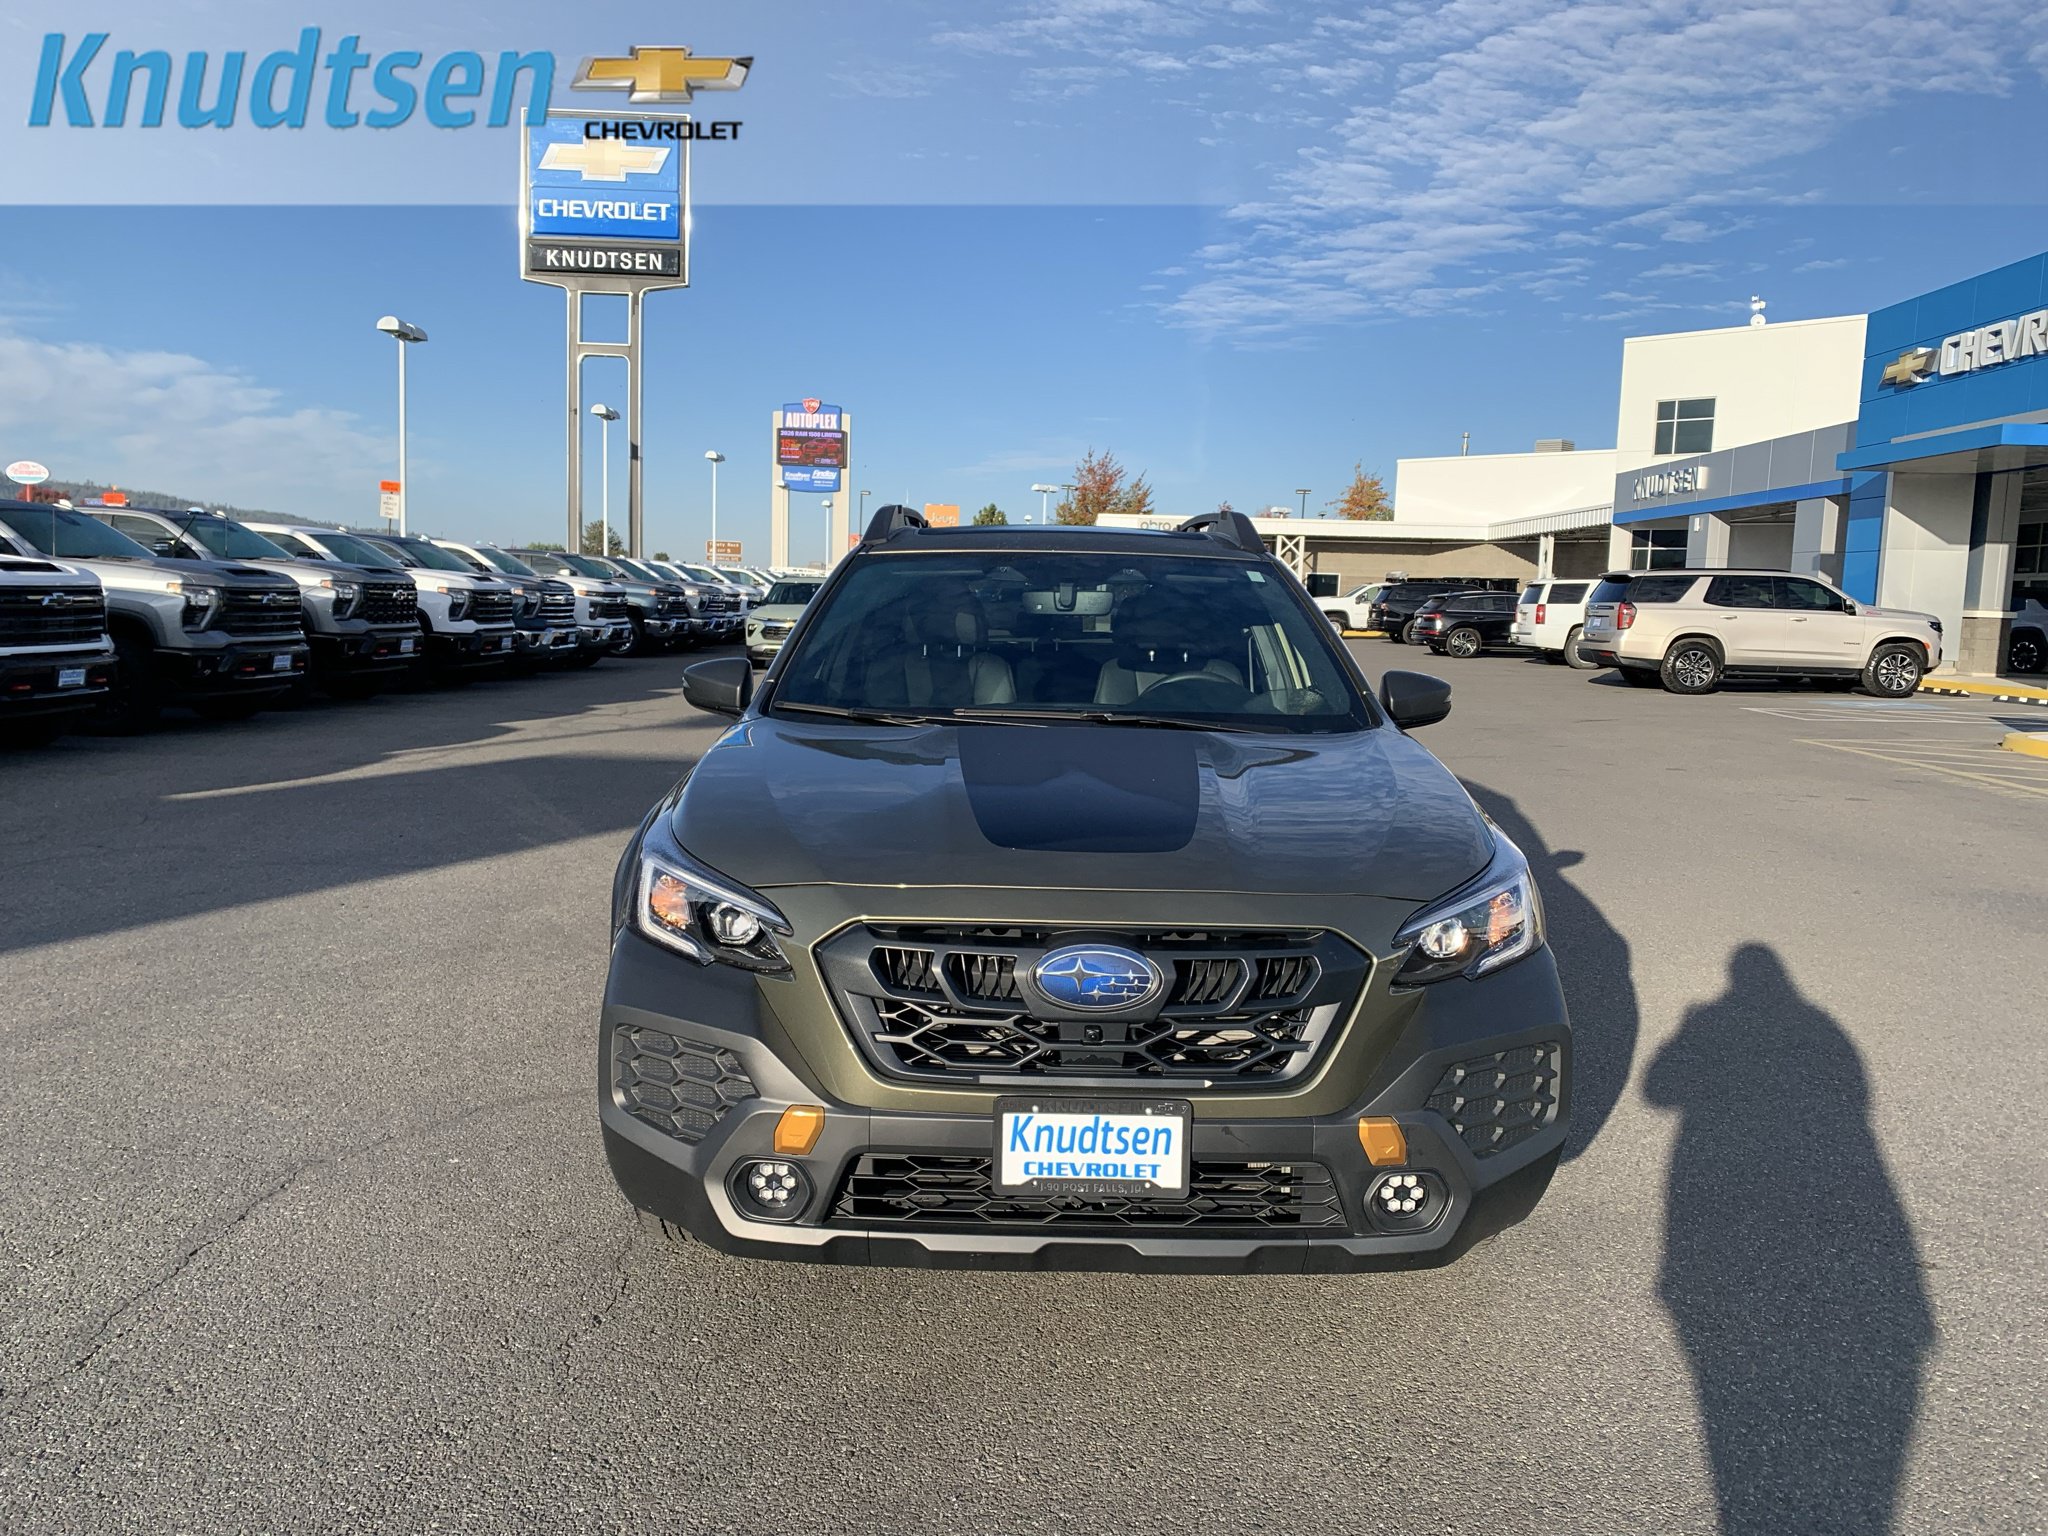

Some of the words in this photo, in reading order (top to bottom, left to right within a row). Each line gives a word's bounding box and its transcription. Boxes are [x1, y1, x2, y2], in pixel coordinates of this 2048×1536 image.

[538, 199, 670, 221] CHEVROLET
[546, 250, 662, 270] KNUDTSEN
[1940, 309, 2048, 376] CHEVR
[785, 412, 838, 429] AUTOPLEX
[1633, 467, 1708, 501] KNUDTSEN
[1010, 1114, 1173, 1155] Knudtsen
[1023, 1161, 1161, 1178] CHEVROLET
[1062, 1184, 1090, 1192] POST
